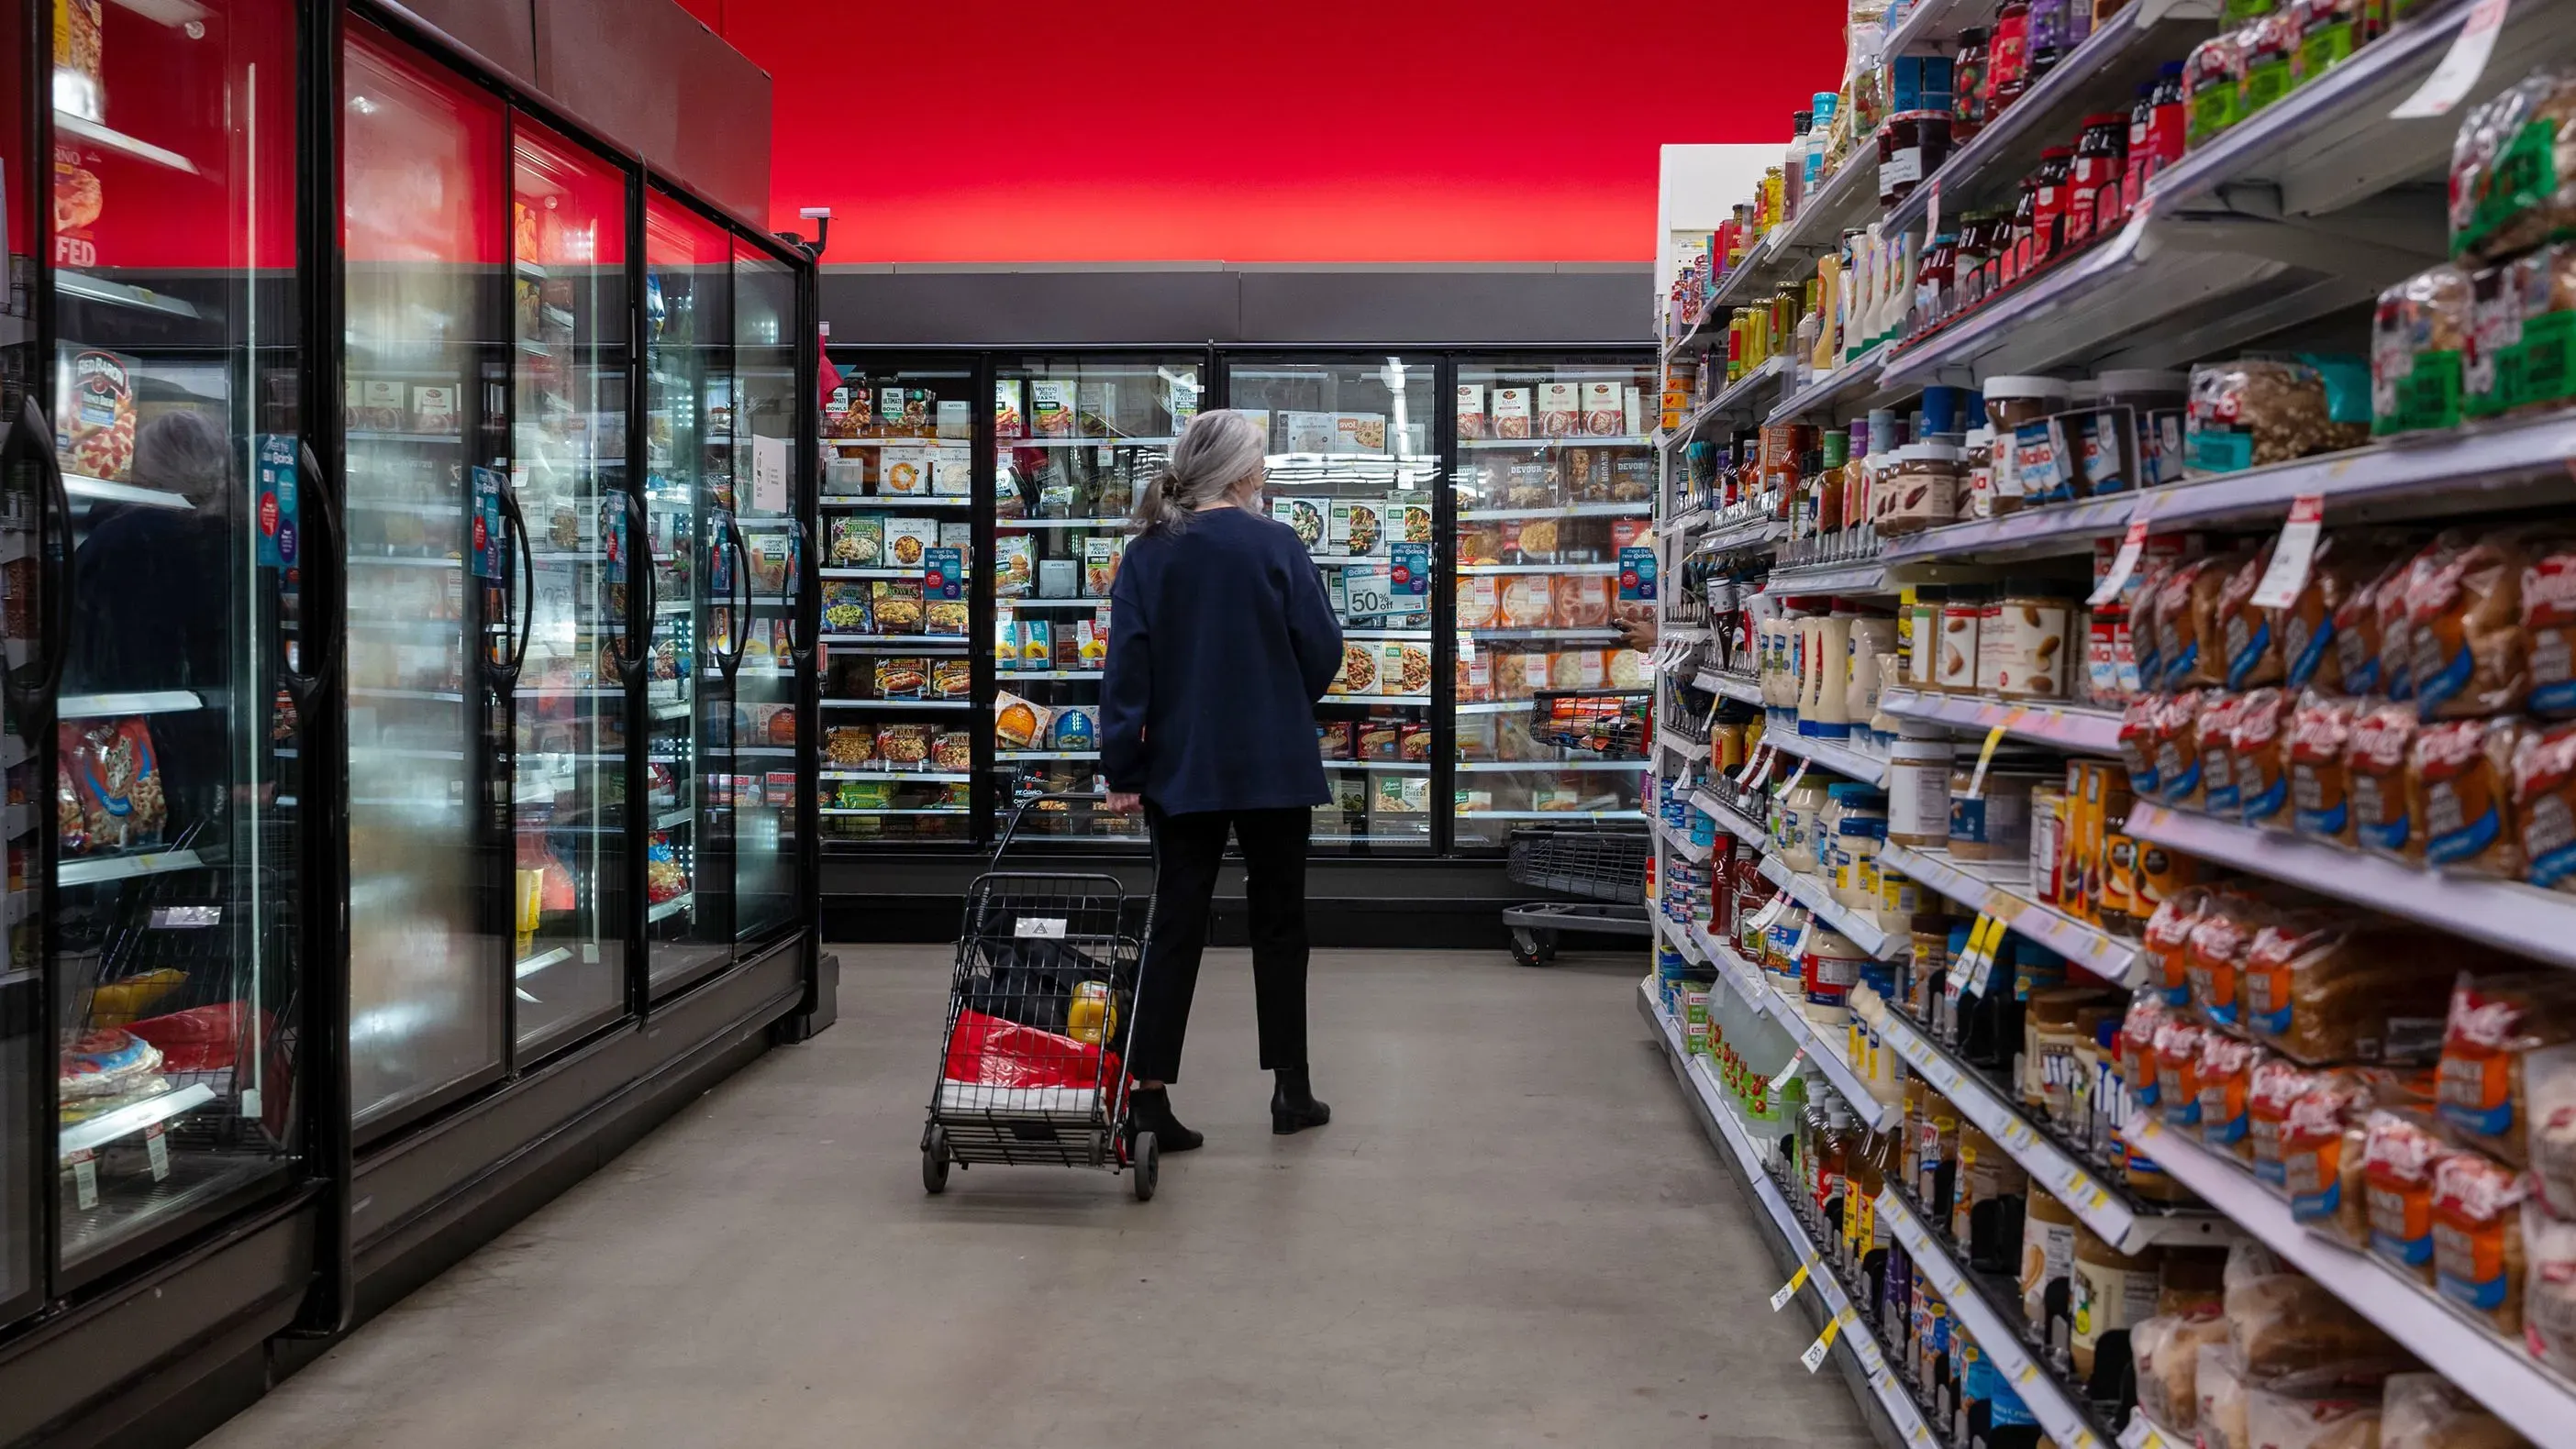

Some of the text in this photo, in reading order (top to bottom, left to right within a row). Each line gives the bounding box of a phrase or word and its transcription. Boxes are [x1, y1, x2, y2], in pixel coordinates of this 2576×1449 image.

[1511, 465, 1543, 474] DEVOUR
[1601, 450, 1609, 482] DEVOUR
[1617, 462, 1649, 470] DEVOUR
[844, 525, 878, 535] BOWLS
[1354, 567, 1372, 575] circle
[1352, 592, 1378, 613] 50
[1378, 593, 1389, 603] %
[1380, 601, 1393, 611] off
